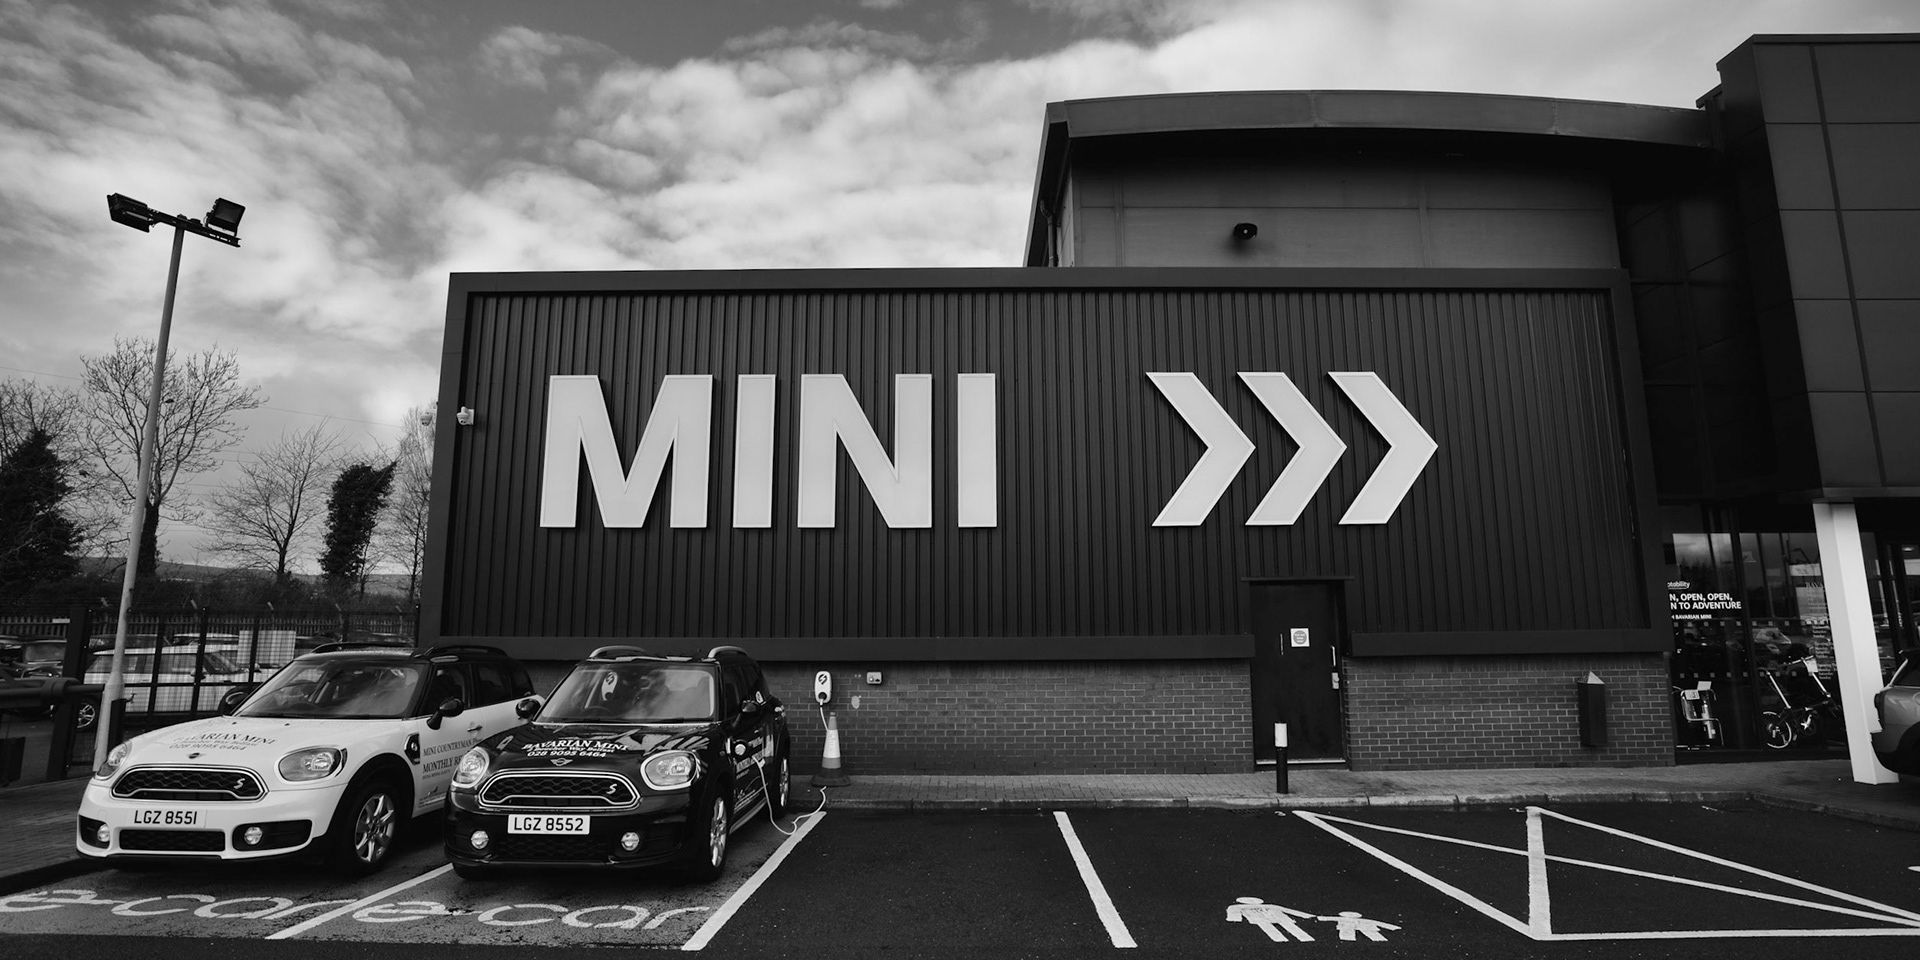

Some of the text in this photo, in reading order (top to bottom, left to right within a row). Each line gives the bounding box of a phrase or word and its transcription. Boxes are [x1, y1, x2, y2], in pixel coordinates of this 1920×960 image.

[540, 373, 997, 528] MINI
[1680, 593, 1706, 602] OPEN,
[1707, 592, 1733, 602] OPEN,
[1678, 602, 1691, 610] TO
[1692, 601, 1742, 610] ADVENTURE
[241, 735, 276, 744] MINI
[521, 740, 628, 751] BAVARIAN MINI
[423, 757, 453, 774] MONTHLY
[134, 810, 198, 825] LGZ 8551
[514, 817, 584, 831] LGZ 8552
[0, 889, 358, 920] e-car
[352, 901, 711, 930] e-car
